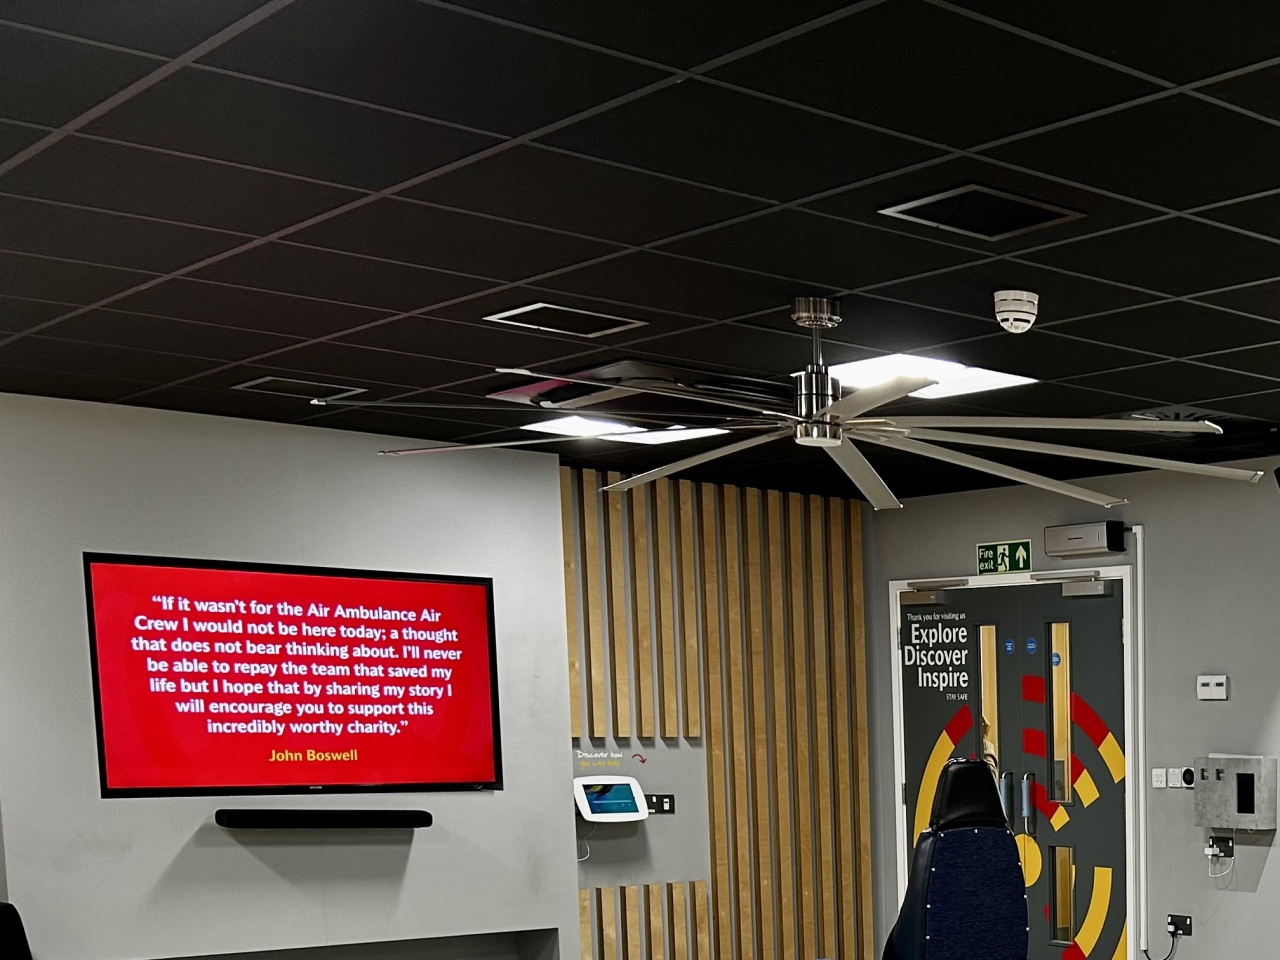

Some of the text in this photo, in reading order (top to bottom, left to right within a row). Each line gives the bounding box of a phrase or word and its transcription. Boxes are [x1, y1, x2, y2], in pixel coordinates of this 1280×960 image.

[979, 548, 994, 559] Fire
[979, 559, 994, 570] exit
[178, 597, 190, 611] it
[250, 600, 273, 614] for
[277, 602, 303, 616] the
[308, 604, 330, 617] Air
[334, 605, 416, 621] Ambulance
[420, 609, 441, 622] Air
[907, 612, 922, 621] Thank
[923, 614, 932, 622] you
[941, 611, 959, 621] visiting
[960, 612, 966, 620] us
[134, 616, 458, 643] Crew I would not be here today; a thought
[911, 622, 967, 648] Explore
[131, 636, 167, 651] that
[171, 638, 210, 652] does
[215, 641, 242, 653] not
[246, 640, 282, 654] bear
[286, 642, 349, 659] thinking
[353, 644, 398, 658] about.
[424, 650, 462, 660] never
[904, 645, 968, 666] Discover
[147, 658, 452, 680] be able to repay the team that saved my
[150, 678, 452, 698] life but I hope that by sharing my story I
[918, 666, 969, 692] Inspire
[946, 693, 968, 701] STAY SAFE
[176, 699, 433, 716] will encourage you to support this
[208, 719, 285, 736] incredibly
[290, 720, 343, 736] worthy
[270, 750, 357, 761] John Boswell
[576, 749, 623, 758] Discover how
